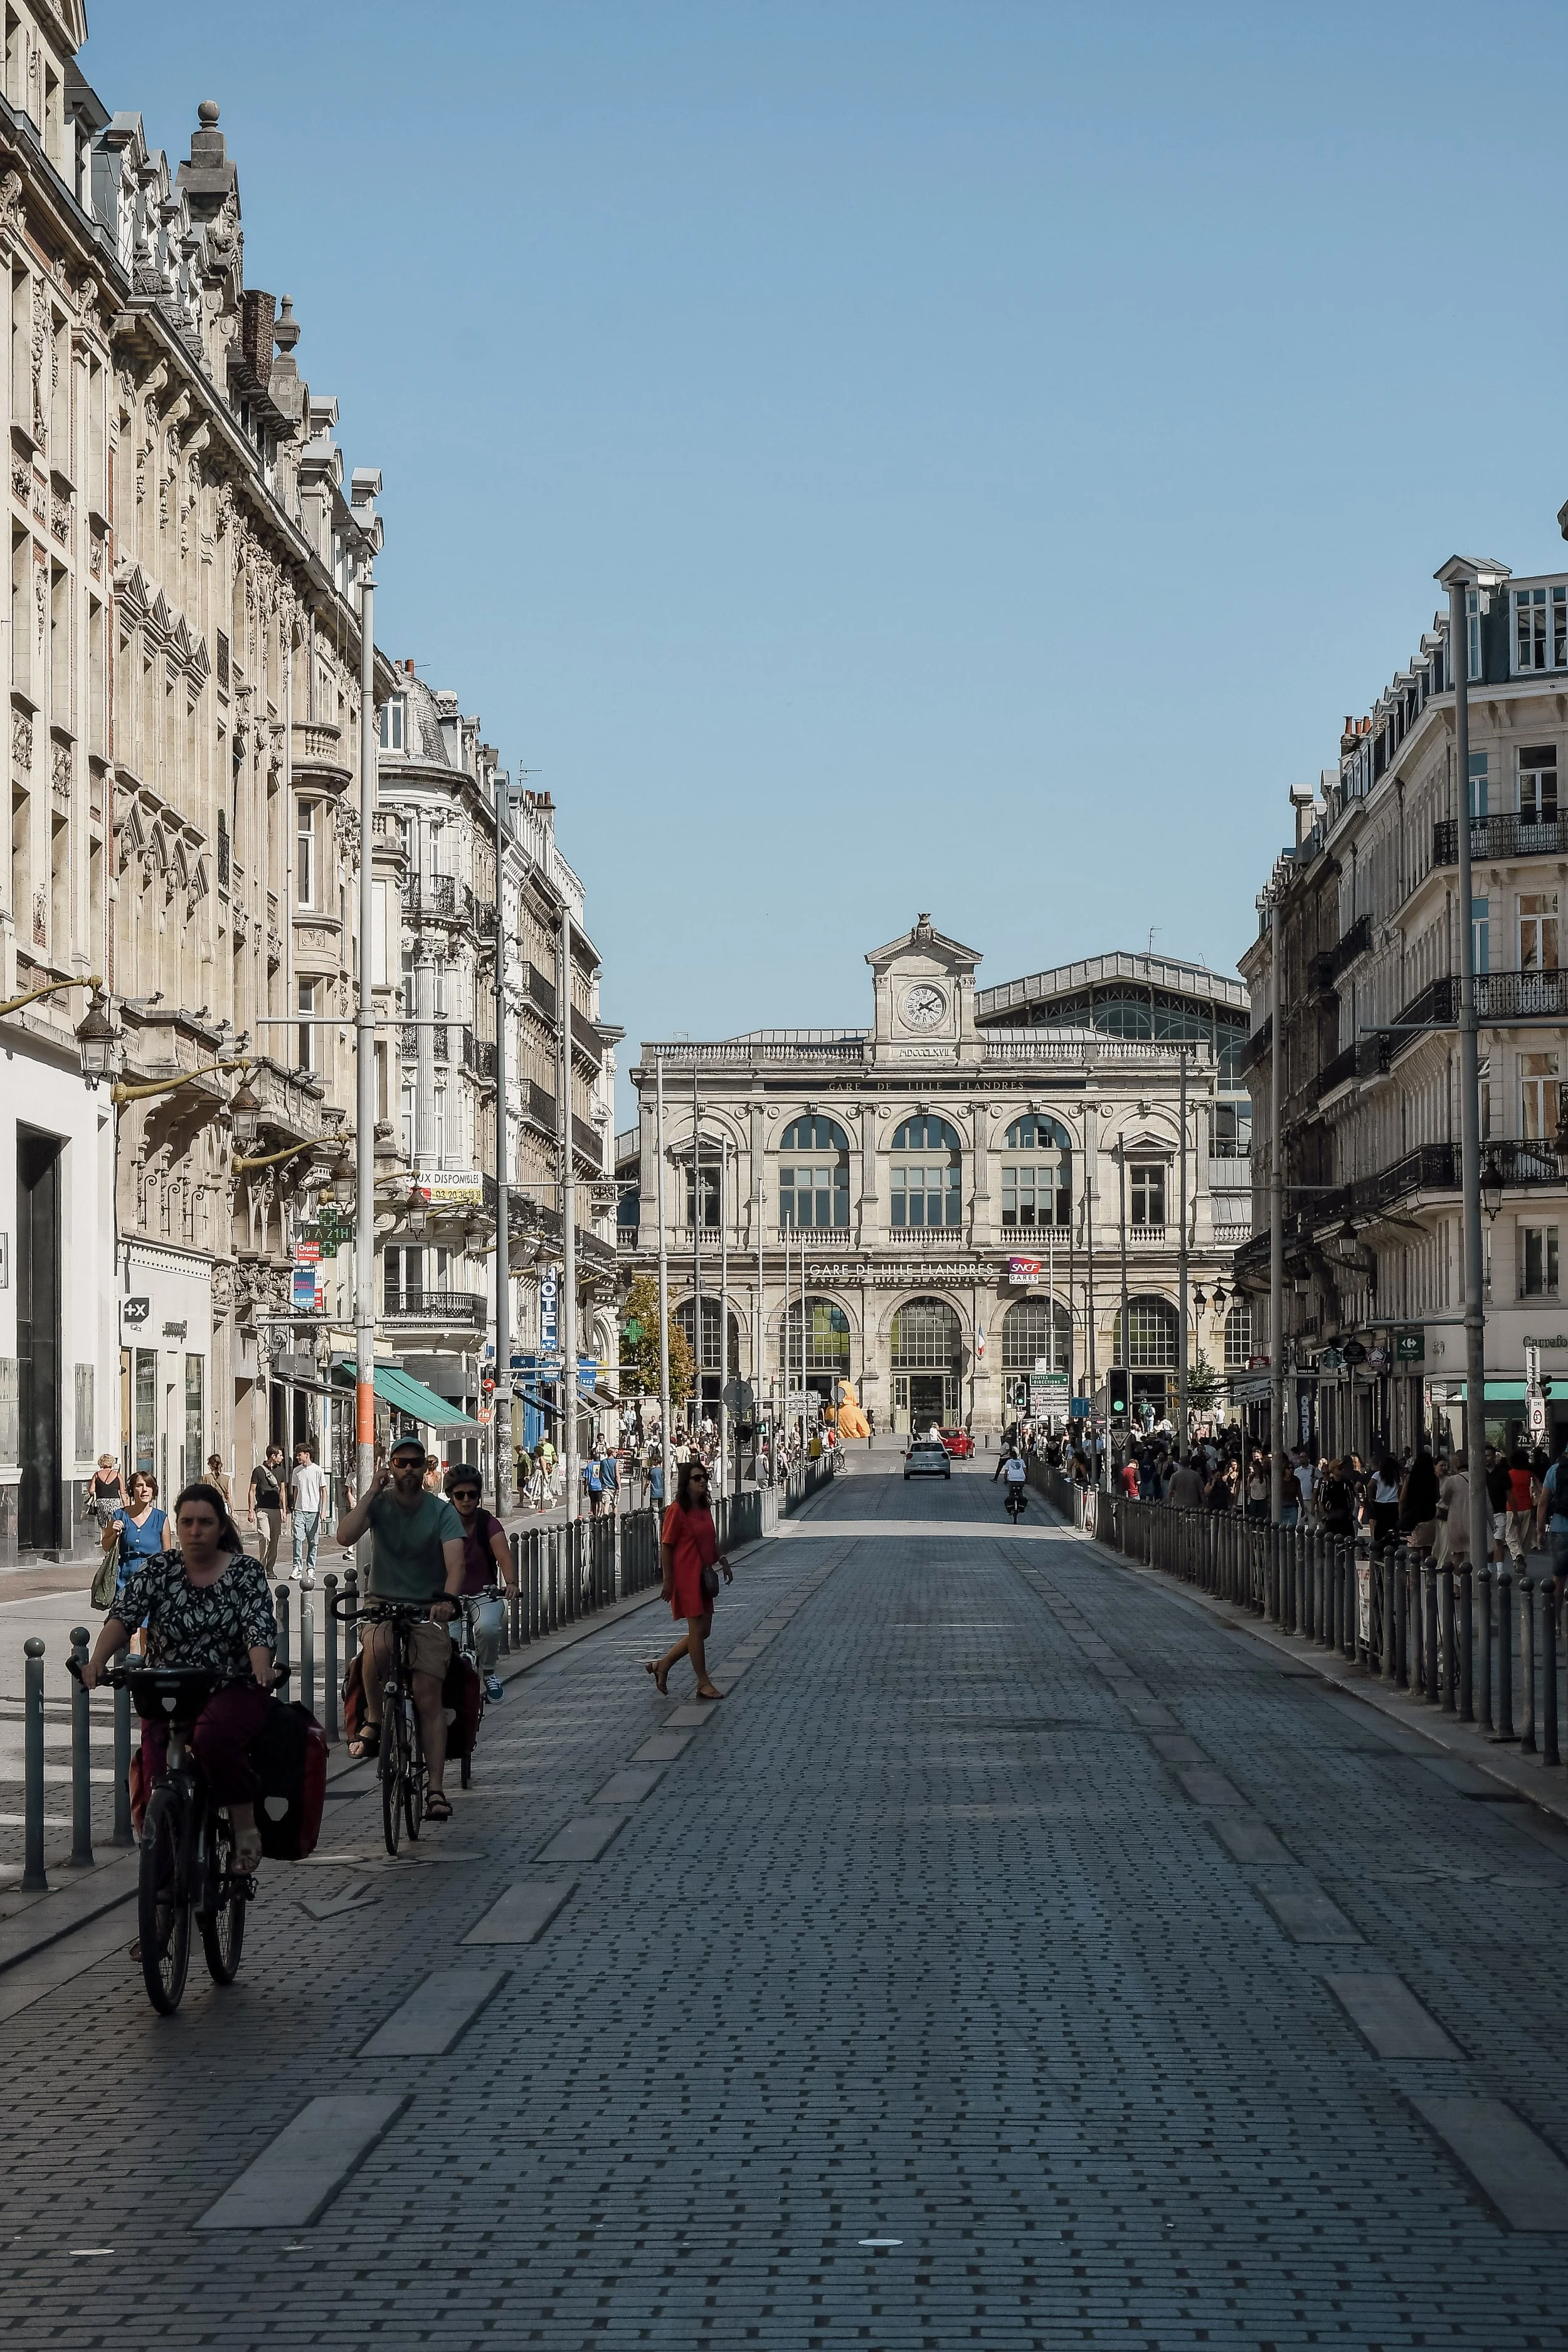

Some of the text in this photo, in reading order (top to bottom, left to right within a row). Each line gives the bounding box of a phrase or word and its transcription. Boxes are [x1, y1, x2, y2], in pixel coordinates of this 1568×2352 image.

[908, 1082, 943, 1090] LILLE
[959, 1082, 1024, 1090] FLANDRES
[434, 1173, 479, 1184] DISPONIBLES
[435, 1190, 446, 1199] 03
[448, 1190, 457, 1199] 20
[327, 1228, 349, 1239] 21H
[299, 1244, 313, 1253] Orpi
[810, 1263, 994, 1275] GARE DE LILLE FLANDRES
[1010, 1263, 1039, 1272] SNCF
[542, 1267, 556, 1340] HOTEL
[1523, 1334, 1568, 1348] Carrefo
[478, 1409, 490, 1418] ria
